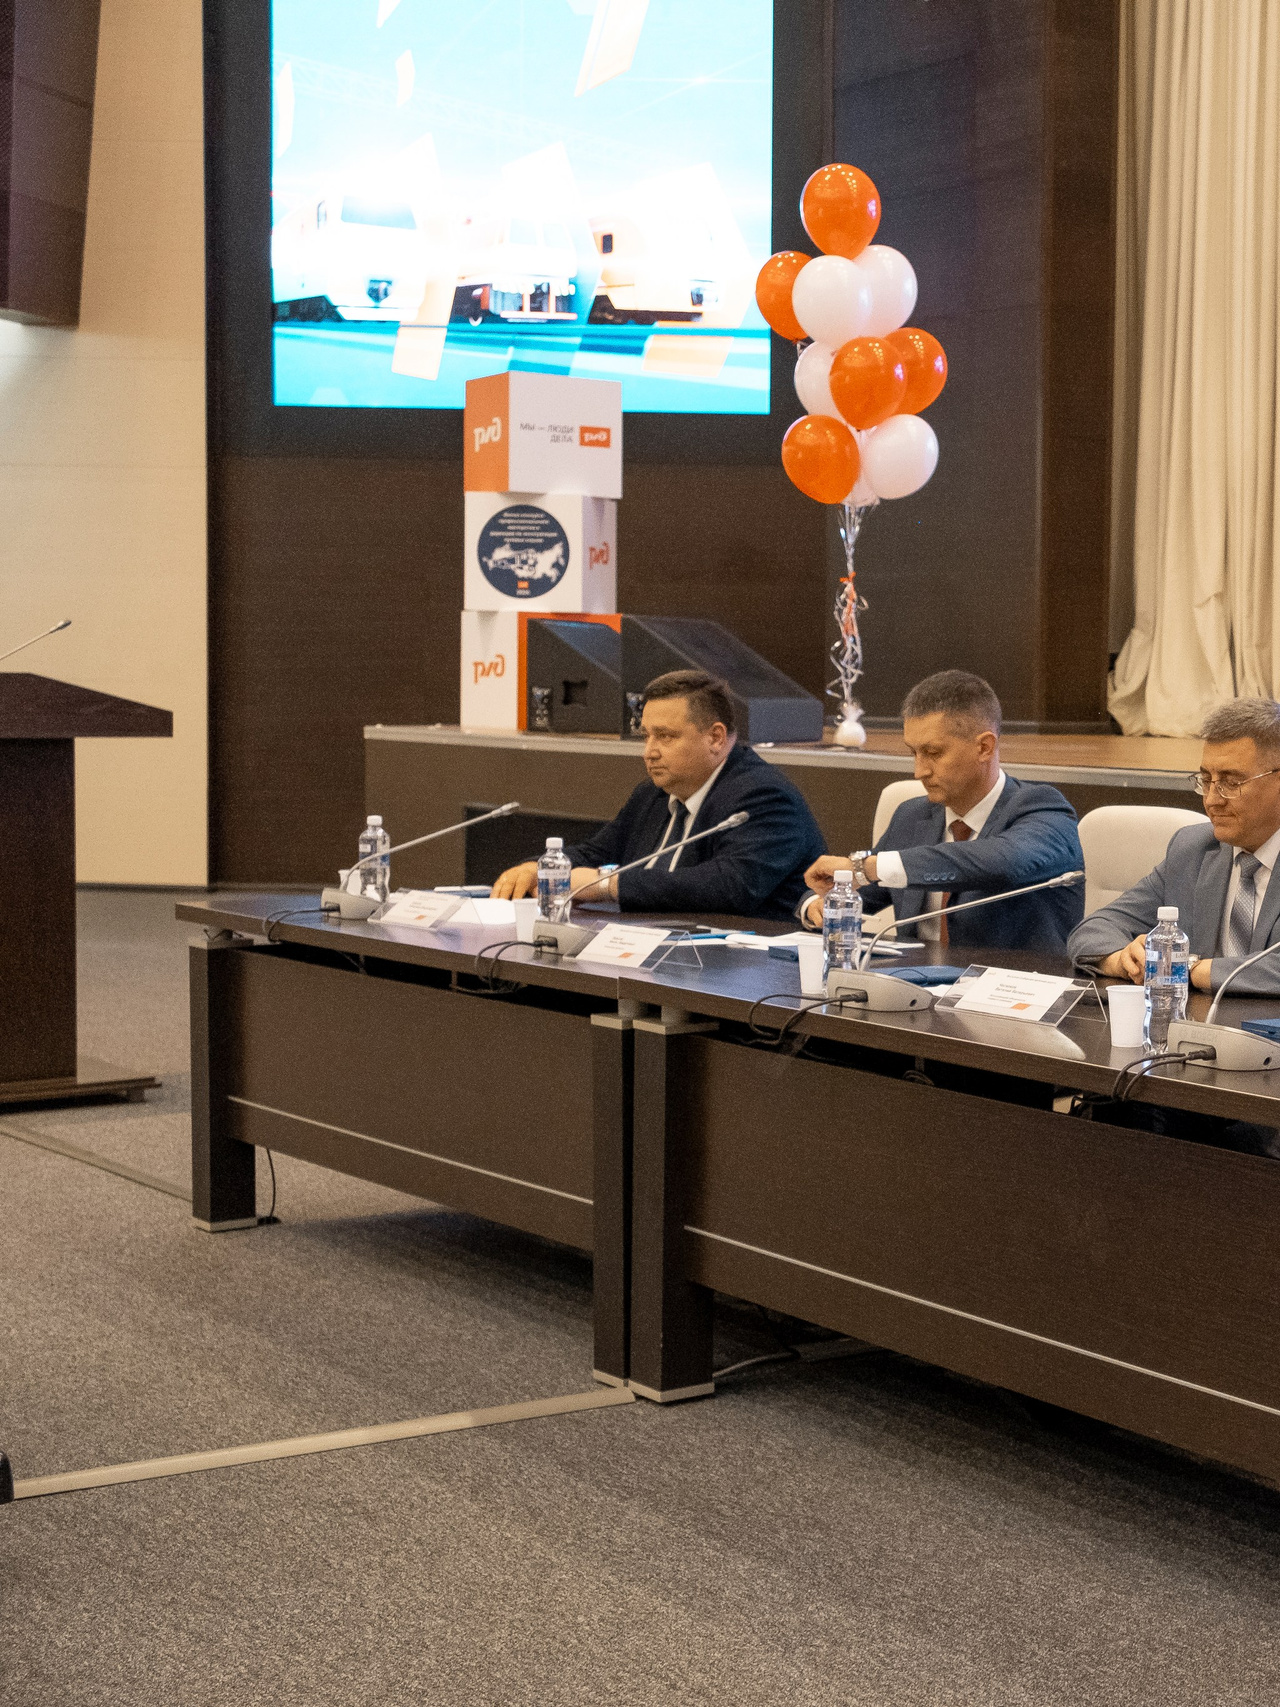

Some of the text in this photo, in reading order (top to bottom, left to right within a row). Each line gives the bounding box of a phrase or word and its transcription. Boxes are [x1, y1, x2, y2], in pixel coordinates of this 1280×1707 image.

[520, 422, 535, 431] МЫ
[547, 424, 574, 434] ЛЮДИ
[549, 434, 573, 443] ДЕЛА
